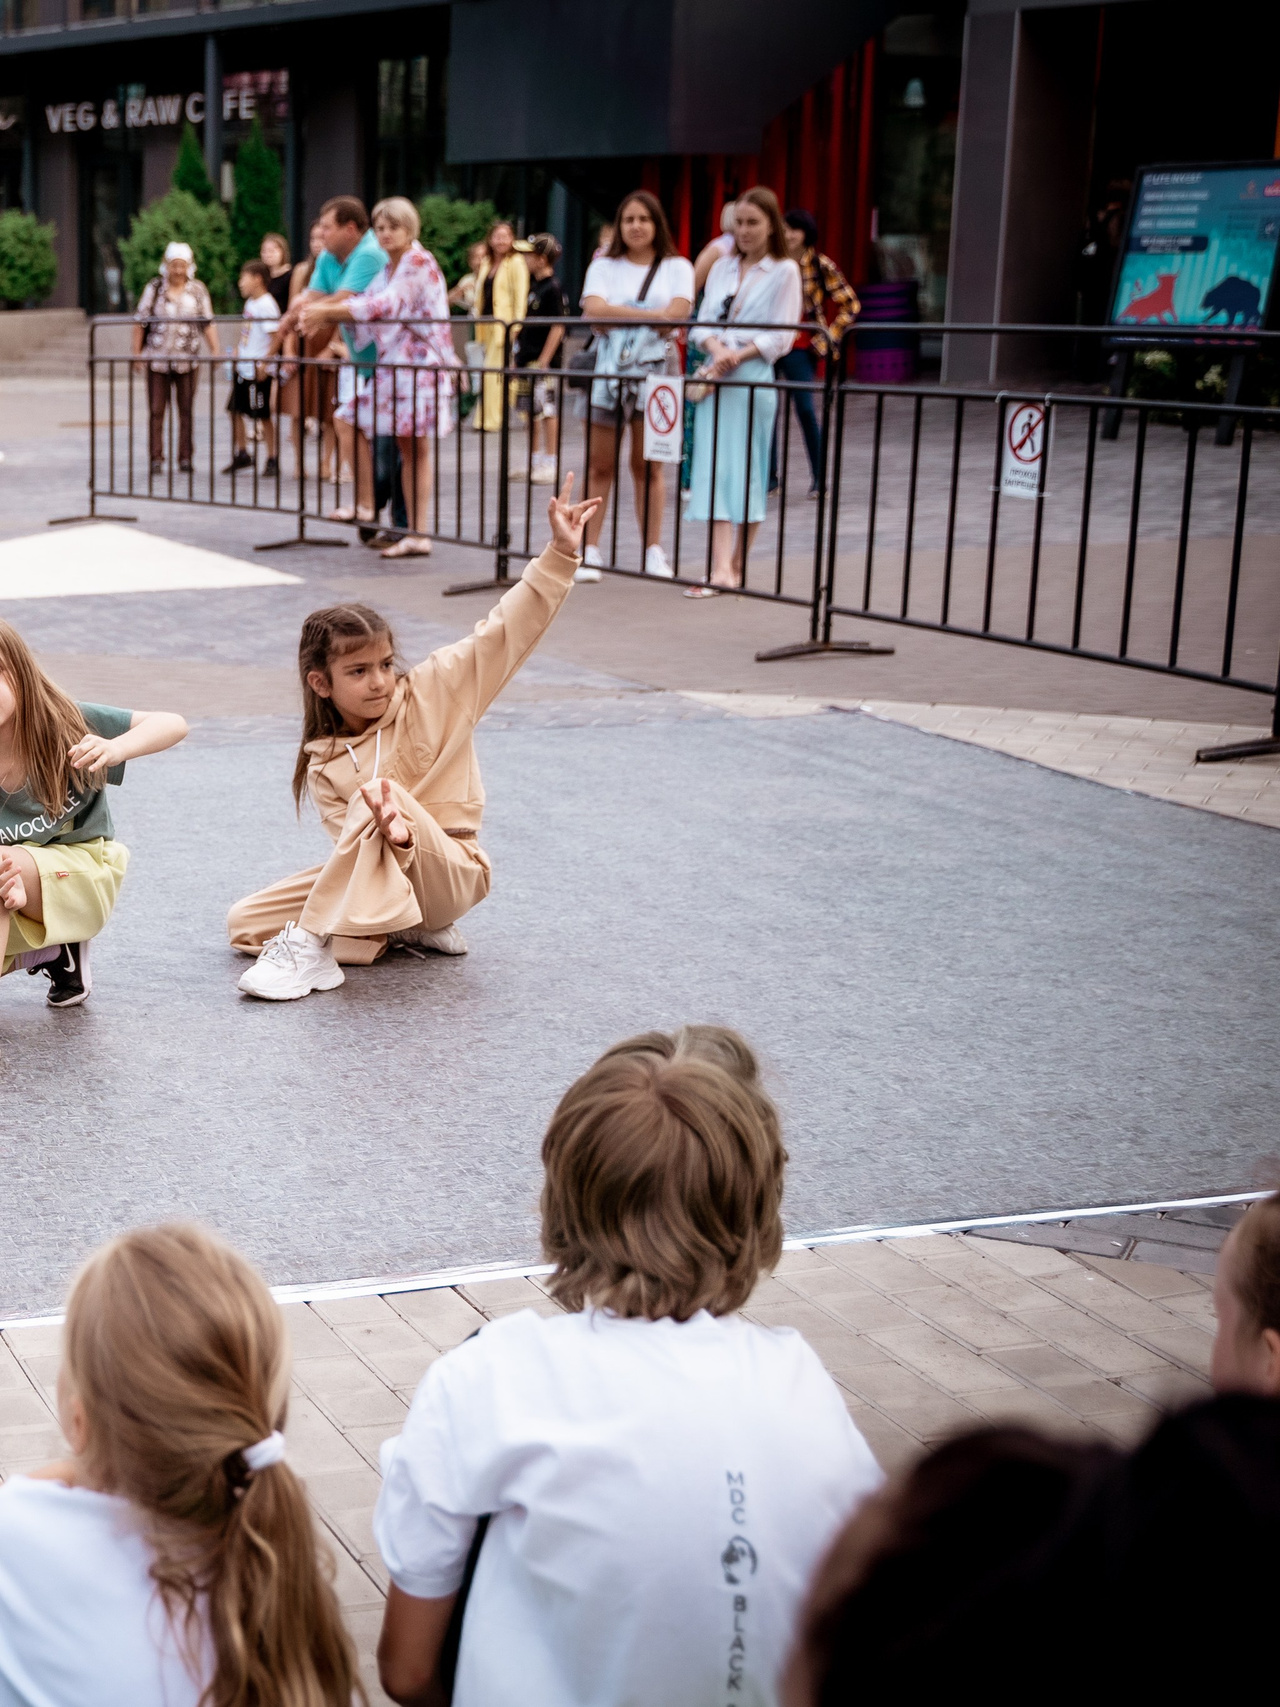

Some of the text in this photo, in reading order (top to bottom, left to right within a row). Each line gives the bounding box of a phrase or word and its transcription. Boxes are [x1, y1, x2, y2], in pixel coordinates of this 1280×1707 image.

[45, 102, 97, 133] VEG
[101, 99, 120, 130] &
[125, 94, 181, 128] RAW
[185, 88, 256, 124] CFE
[0, 790, 80, 844] AVOCULE
[726, 1470, 746, 1525] MDC
[726, 1594, 747, 1690] BLACK
